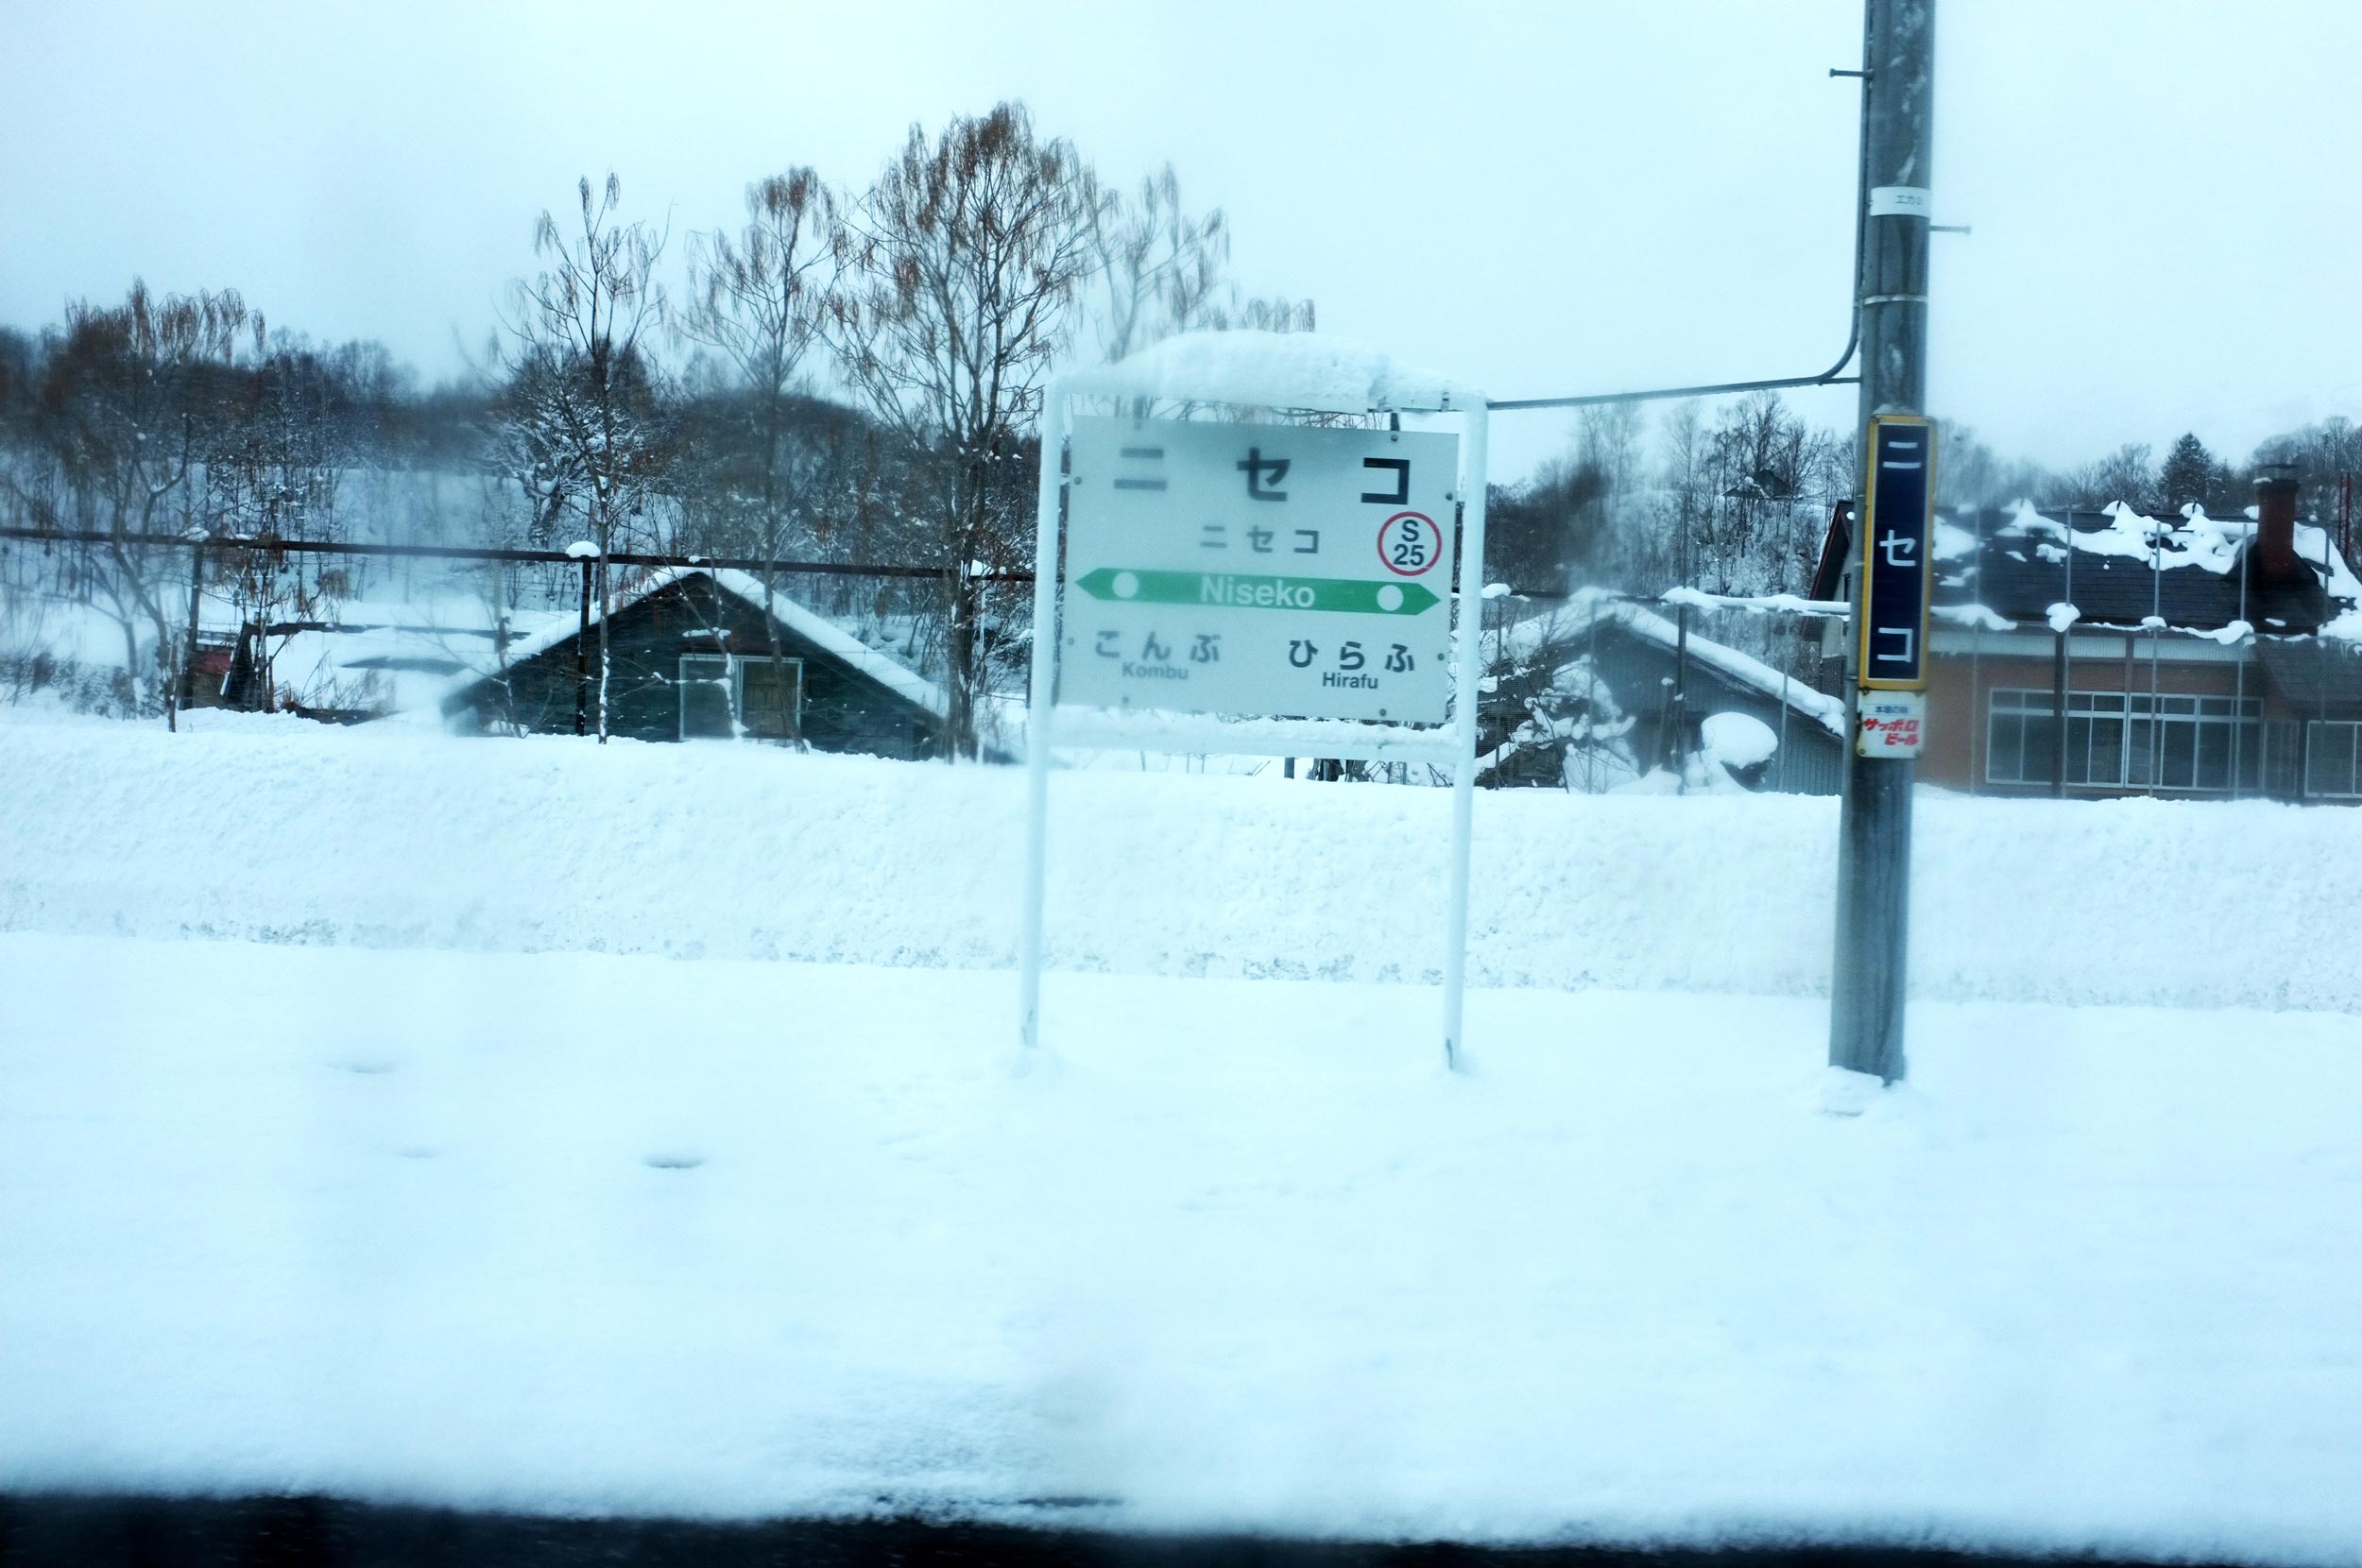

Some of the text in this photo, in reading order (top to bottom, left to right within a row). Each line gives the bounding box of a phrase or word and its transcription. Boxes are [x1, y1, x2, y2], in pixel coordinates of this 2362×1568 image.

[1113, 447, 1411, 505] ニセコ
[1201, 524, 1320, 554] ニセコ
[1400, 519, 1420, 543] S
[1393, 543, 1425, 567] 25
[1875, 440, 1922, 663] ニセコ
[1200, 577, 1316, 608] Niseko
[1095, 630, 1222, 663] こんぶ
[1289, 639, 1415, 673] ひらふ
[1121, 662, 1190, 681] Kombu
[1322, 671, 1379, 690] Hirafu
